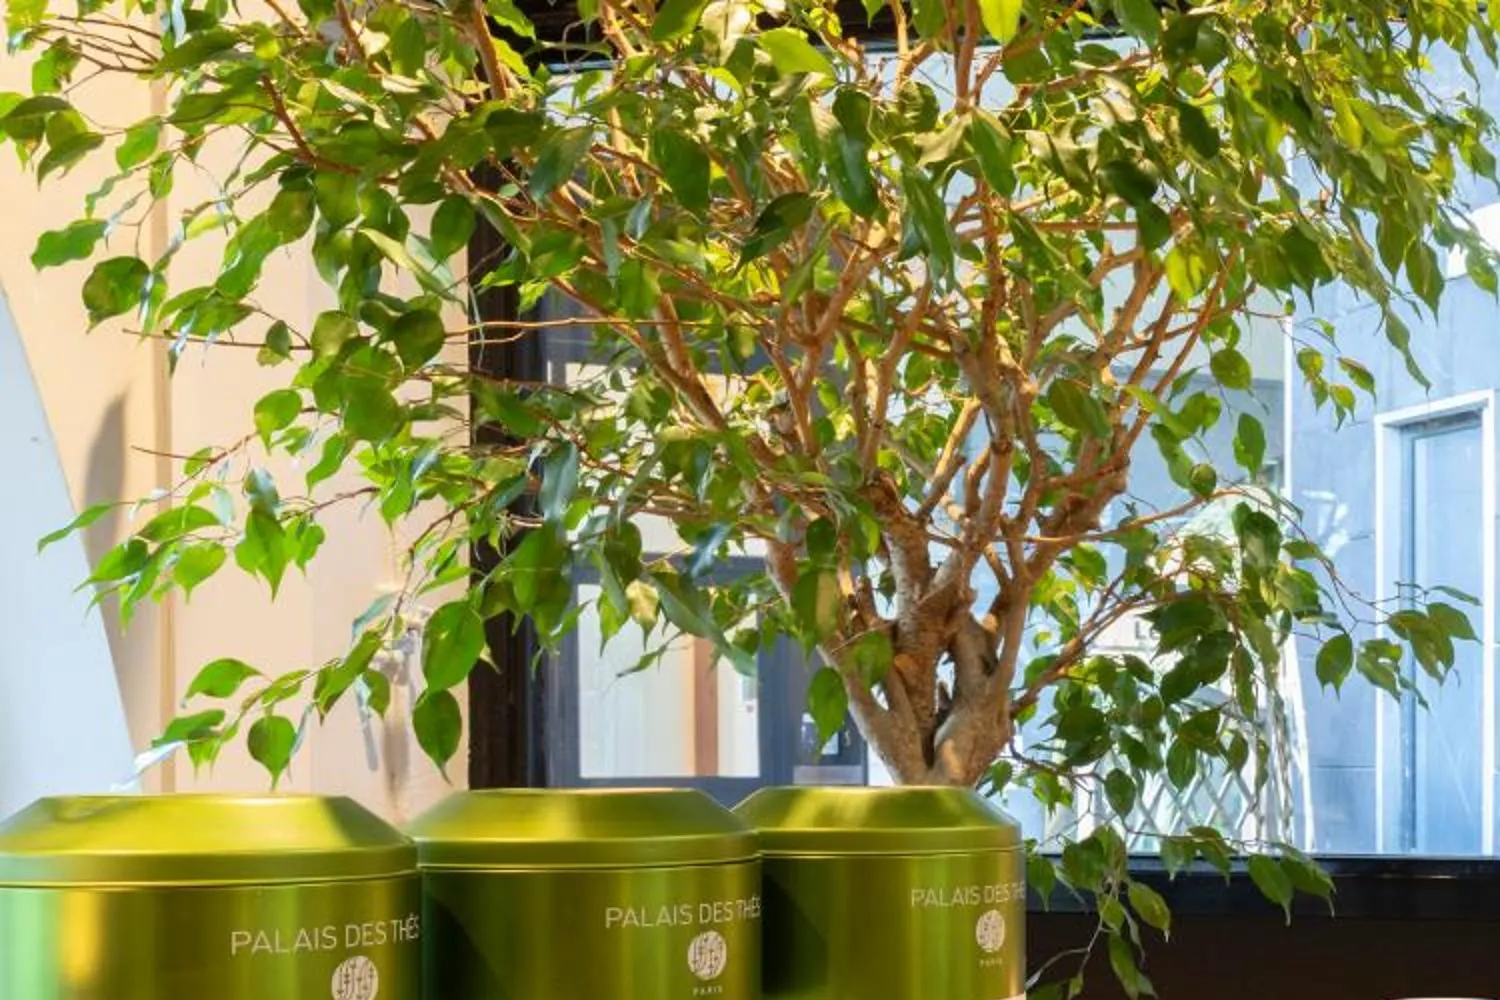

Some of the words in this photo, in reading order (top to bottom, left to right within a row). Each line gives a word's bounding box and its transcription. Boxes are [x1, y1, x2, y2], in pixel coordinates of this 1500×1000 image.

[911, 886, 980, 907] PALAIS
[983, 883, 1010, 904] DES
[604, 903, 694, 929] PALAIS
[699, 900, 734, 925] DES
[230, 925, 338, 956] PALAIS
[344, 921, 388, 949] DES
[692, 985, 724, 997] PARIS
